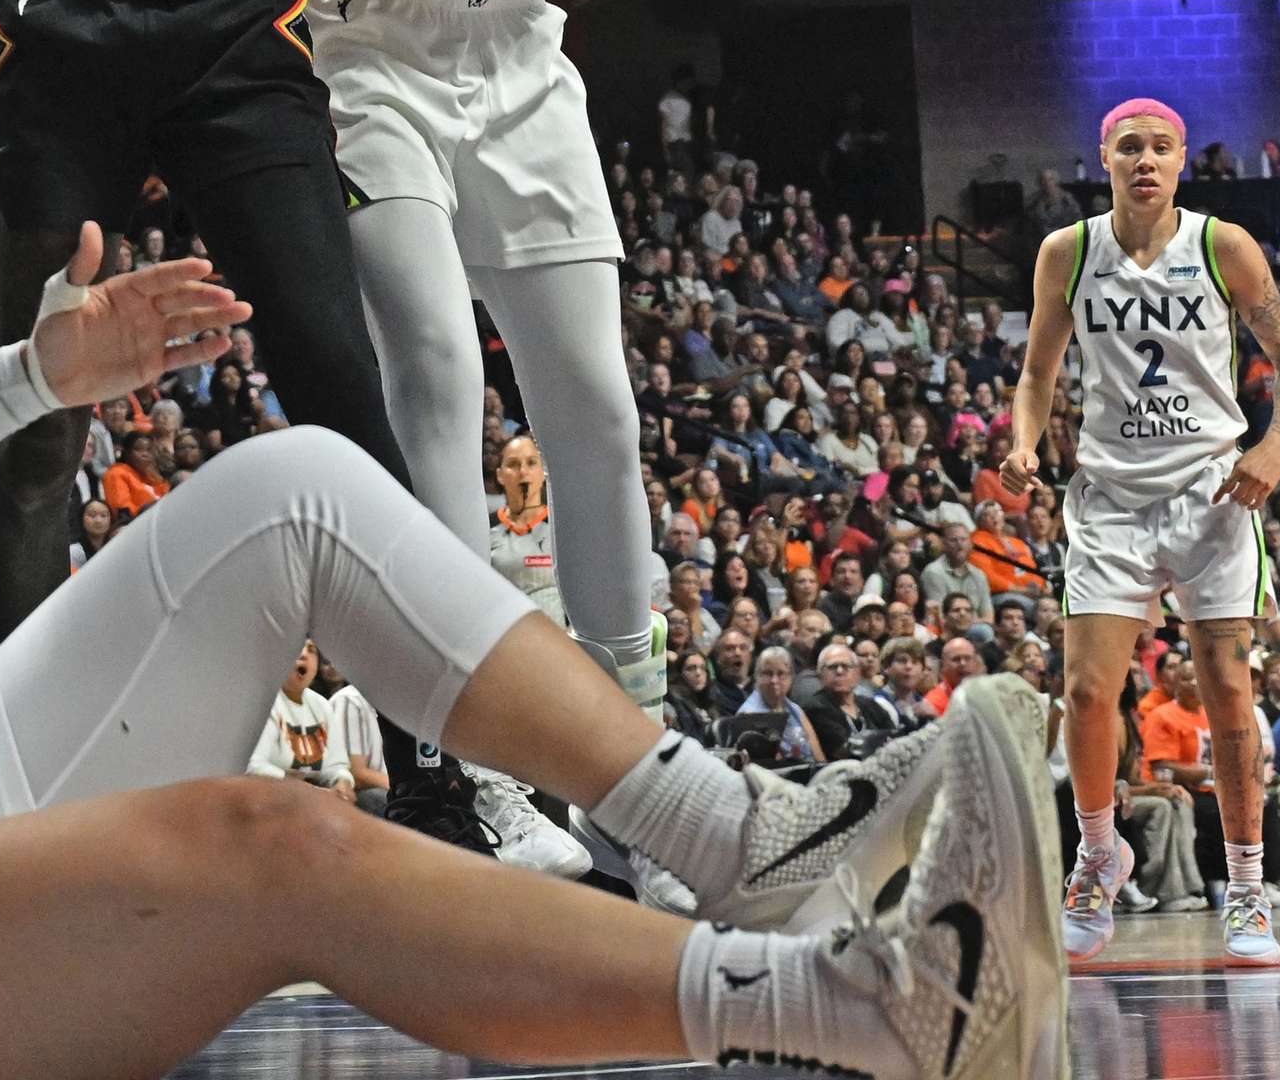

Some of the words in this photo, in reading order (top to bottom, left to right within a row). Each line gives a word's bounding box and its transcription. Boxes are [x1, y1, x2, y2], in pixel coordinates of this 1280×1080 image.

[1084, 296, 1207, 333] LYNX
[1135, 339, 1169, 388] 2
[1124, 394, 1189, 416] MAYO
[1120, 416, 1202, 439] CLINIC
